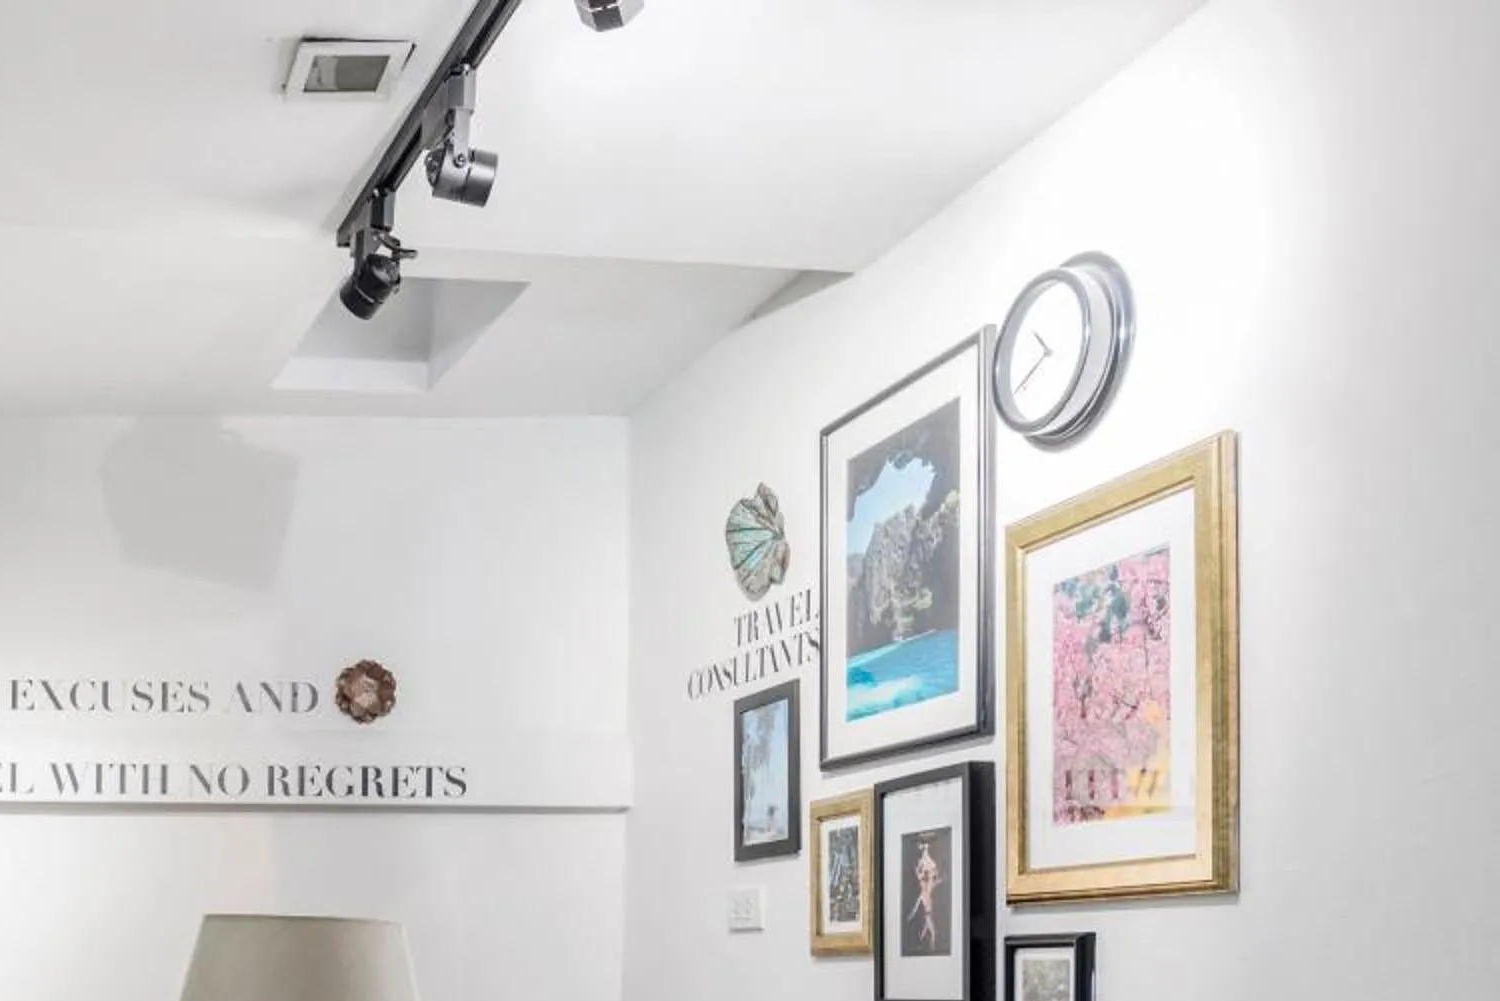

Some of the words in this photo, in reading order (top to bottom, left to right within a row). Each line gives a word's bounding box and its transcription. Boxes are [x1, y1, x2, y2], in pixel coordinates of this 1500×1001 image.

[733, 588, 820, 648] TRAVEL
[686, 627, 820, 701] CONSULTANTS
[10, 678, 210, 714] EXCUSES
[230, 681, 320, 714] AND
[49, 762, 170, 797] WITH
[188, 763, 251, 798] NO
[266, 763, 468, 799] REGRETS
